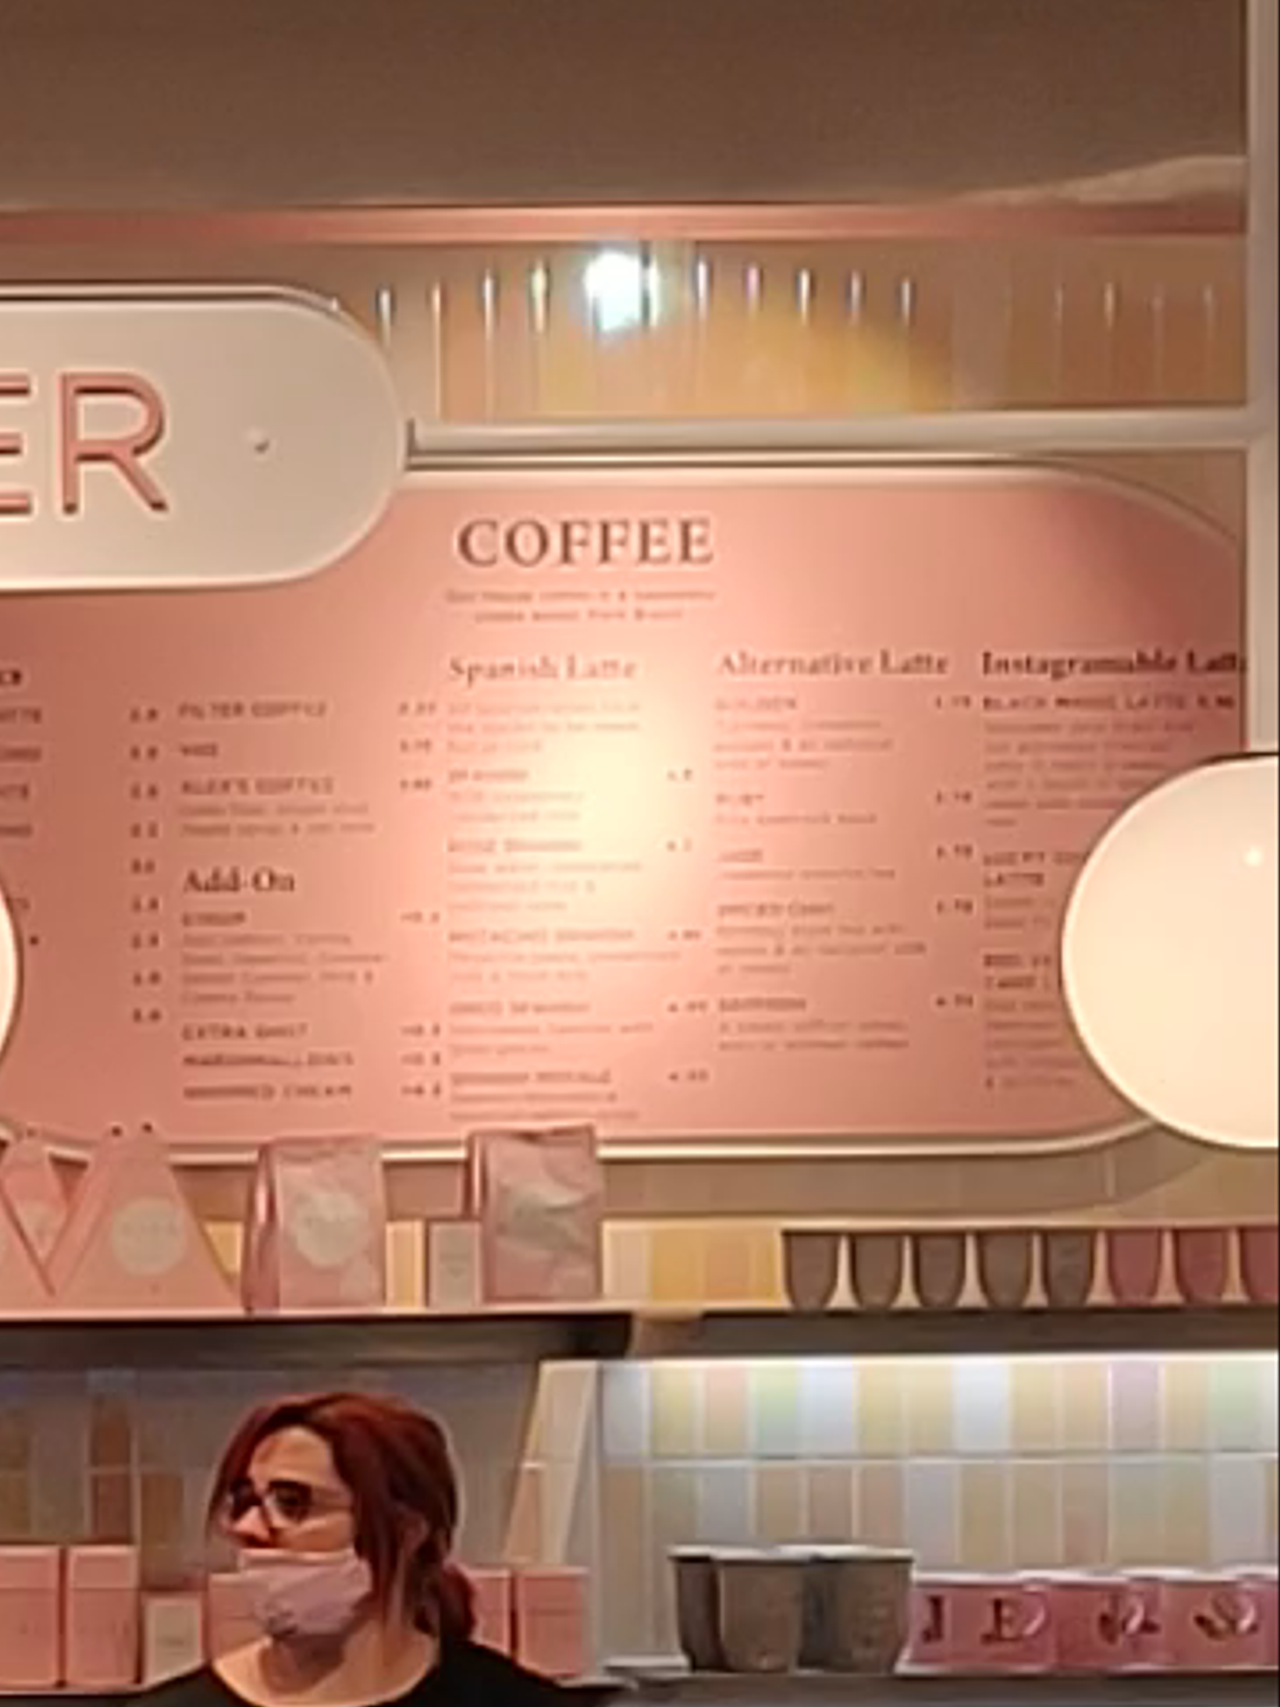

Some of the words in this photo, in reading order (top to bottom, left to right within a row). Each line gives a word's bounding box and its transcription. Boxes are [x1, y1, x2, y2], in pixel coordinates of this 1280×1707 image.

[456, 518, 714, 568] COFFEE
[448, 655, 558, 687] Spanish
[566, 654, 636, 679] Latte
[717, 650, 873, 676] Alternative
[880, 648, 948, 676] Latte
[184, 865, 296, 893] Add-On
